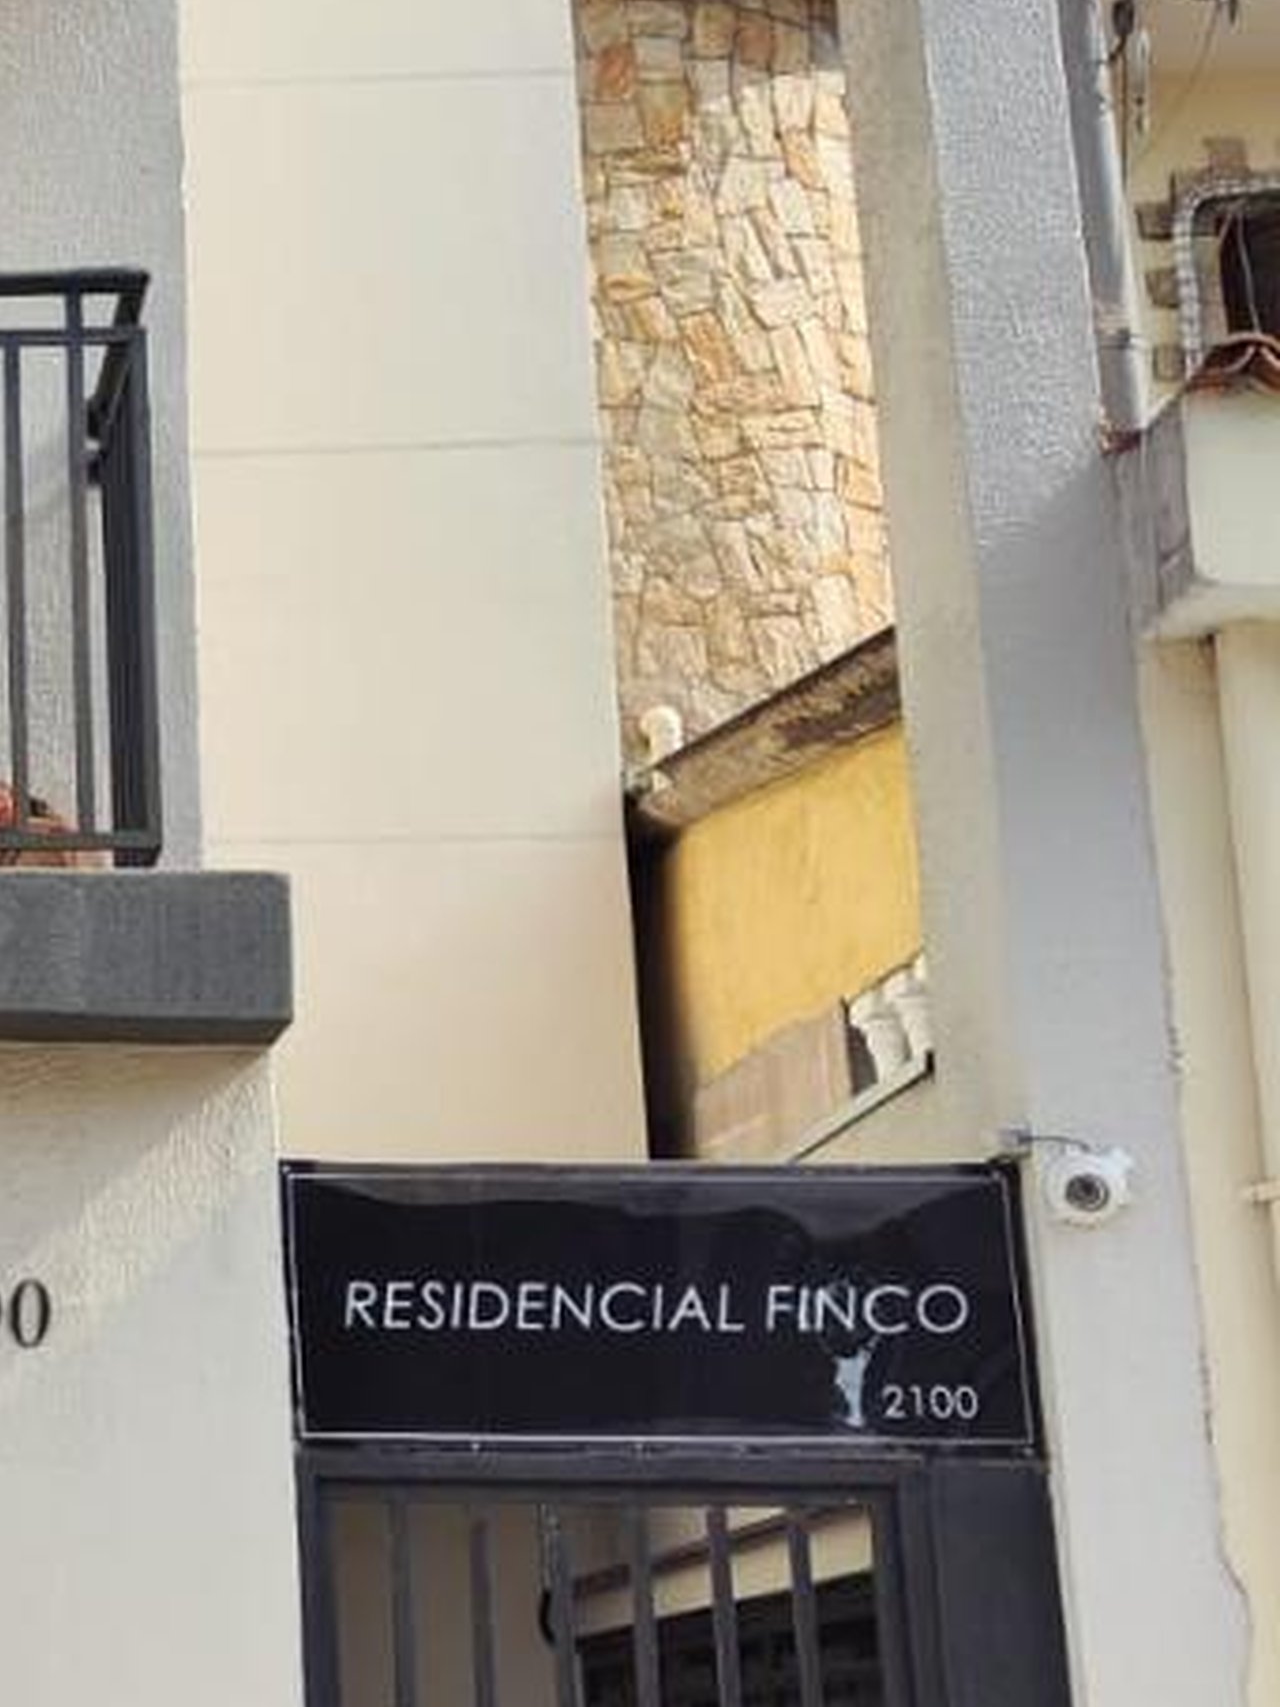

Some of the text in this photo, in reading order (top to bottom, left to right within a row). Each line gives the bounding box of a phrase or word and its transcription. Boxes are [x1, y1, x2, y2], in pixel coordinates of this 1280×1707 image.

[344, 1280, 969, 1335] RESIDENCIAL FINCO
[882, 1384, 979, 1420] 2100
